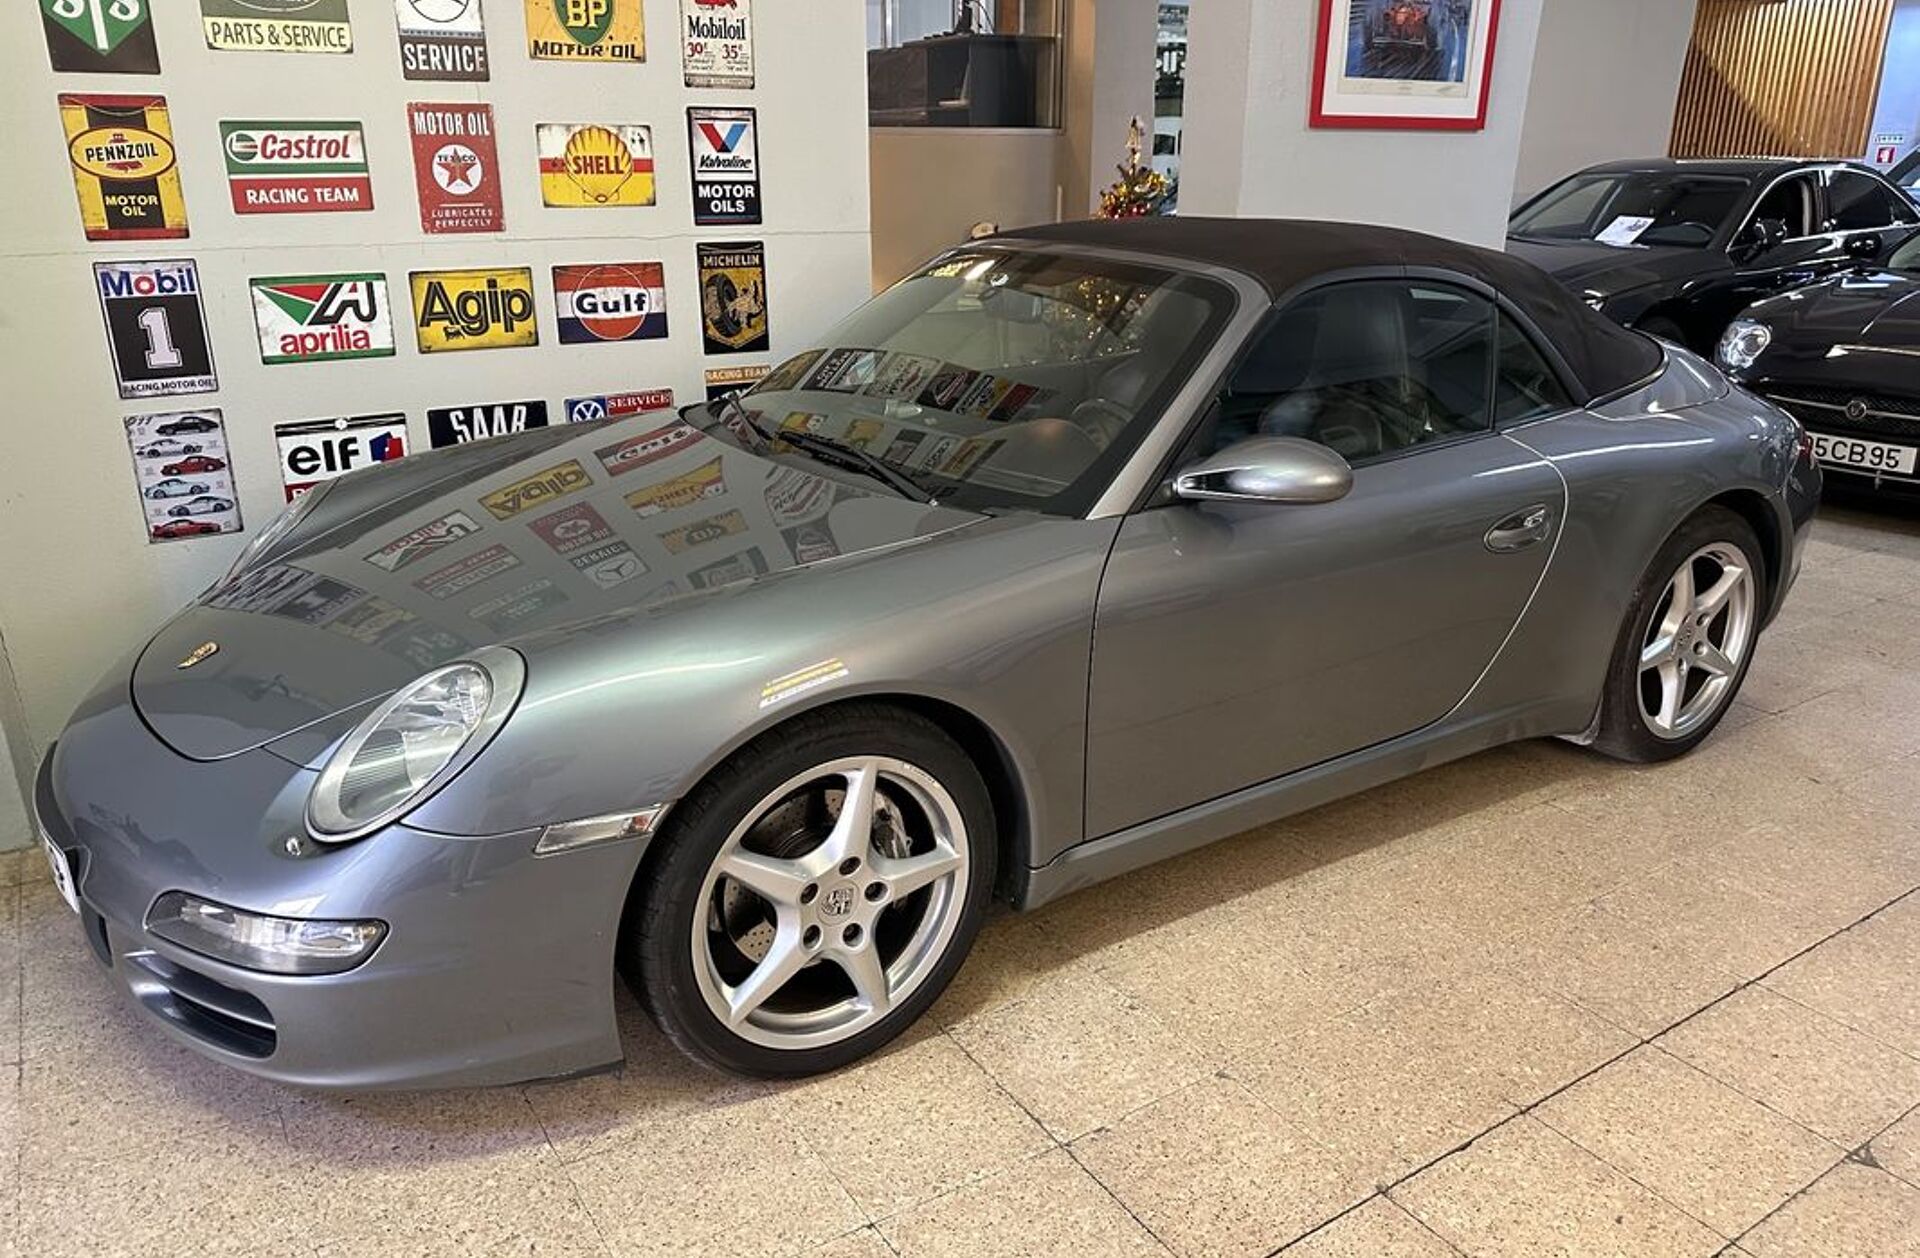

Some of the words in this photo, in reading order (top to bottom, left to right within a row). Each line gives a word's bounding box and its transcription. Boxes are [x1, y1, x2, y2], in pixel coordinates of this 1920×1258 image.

[565, 0, 608, 28] BP
[211, 22, 264, 44] PARTS
[267, 24, 280, 45] &
[282, 25, 347, 47] SERVICE
[686, 15, 747, 40] Mobiloil
[403, 43, 485, 72] SERVICE
[533, 40, 603, 57] MOTOR
[610, 44, 641, 60] OIL
[414, 111, 464, 136] MOTOR
[468, 112, 490, 137] OIL
[85, 143, 159, 163] PENNZOIL
[260, 133, 350, 160] Castrol
[573, 154, 625, 176] SHELL
[698, 153, 753, 170] Valvoline
[105, 194, 159, 207] MOTOR
[246, 188, 309, 205] RACING
[314, 187, 359, 202] TEAM
[698, 184, 755, 199] MOTOR
[121, 205, 147, 218] OIL
[431, 207, 493, 219] LUBRICATES
[710, 200, 746, 213] OILS
[435, 217, 493, 229] PERFECTLY
[703, 253, 760, 268] MICHELIN
[100, 268, 196, 297] Mobil
[419, 278, 533, 336] Agip
[575, 290, 648, 316] Gulf
[138, 306, 183, 369] 1
[280, 324, 371, 358] aprilia
[161, 379, 197, 391] MOTOR
[607, 394, 671, 409] SERVICE
[287, 436, 360, 475] elf
